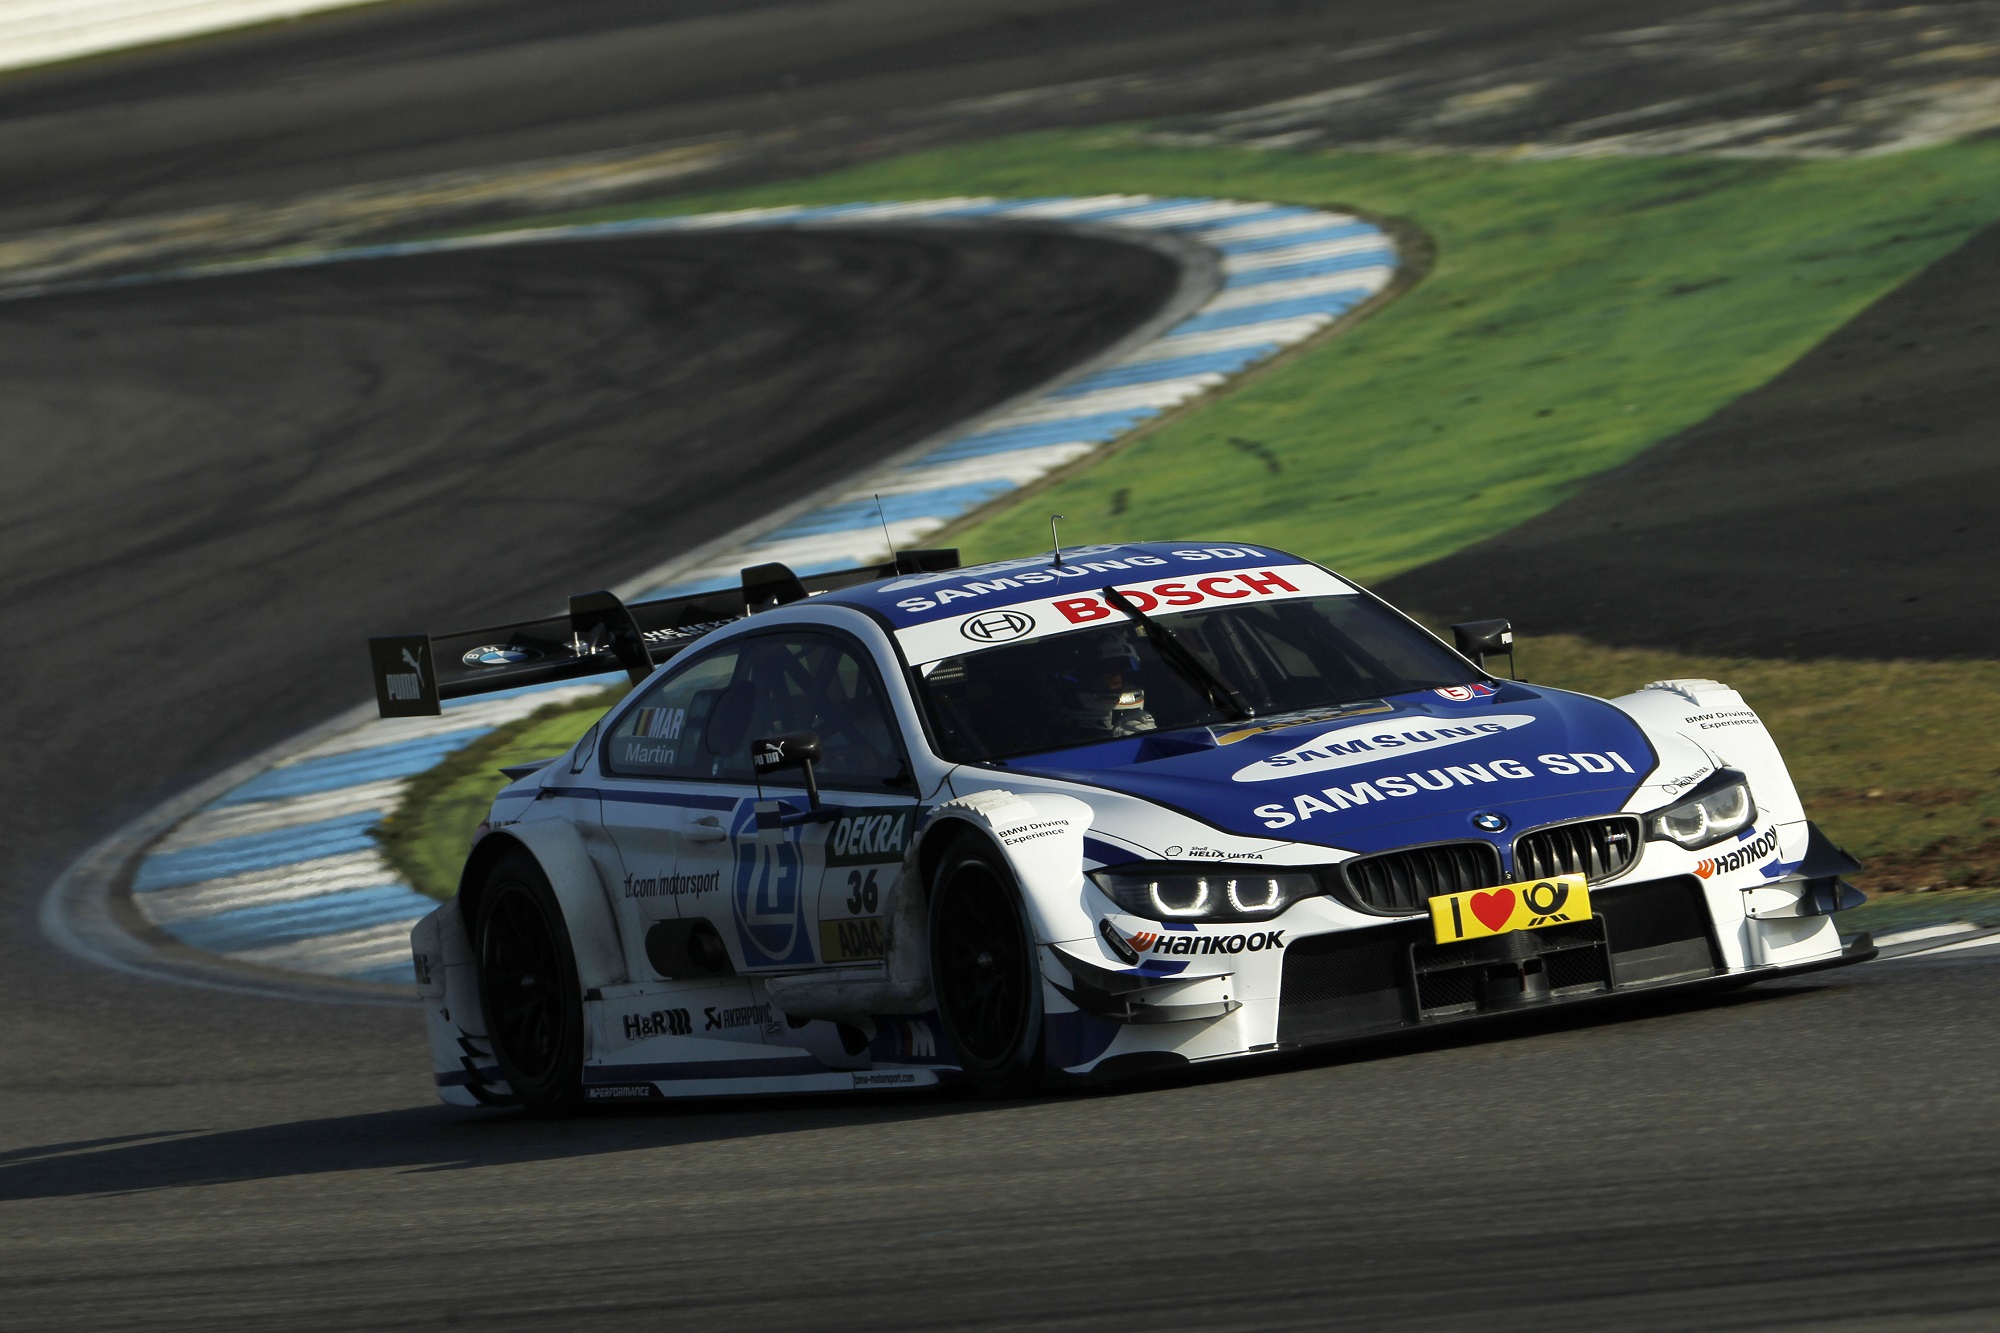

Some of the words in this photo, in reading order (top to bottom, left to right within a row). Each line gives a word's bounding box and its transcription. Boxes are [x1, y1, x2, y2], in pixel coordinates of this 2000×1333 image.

[896, 555, 1168, 612] SAMSUNG
[1171, 547, 1266, 561] SDI
[1052, 571, 1300, 624] BOSCH
[386, 673, 421, 701] PUMA
[648, 707, 685, 740] MAR
[1684, 713, 1714, 723] BMW
[1715, 710, 1754, 719] Driving
[1699, 718, 1759, 730] Experience
[625, 743, 674, 765] Martin
[1262, 723, 1507, 767] SAMSUNG
[1253, 759, 1535, 829] SAMSUNG
[1537, 751, 1636, 775] SDI
[834, 813, 907, 856] DEKRA
[998, 825, 1028, 838] BMW
[1029, 819, 1069, 830] Driving
[1004, 828, 1065, 846] Experience
[1188, 849, 1225, 858] HELIX
[1227, 852, 1263, 860] ULTRA
[847, 869, 879, 915] 36
[1450, 896, 1464, 938] I
[837, 919, 884, 957] ADAC
[623, 1010, 667, 1040] H&R
